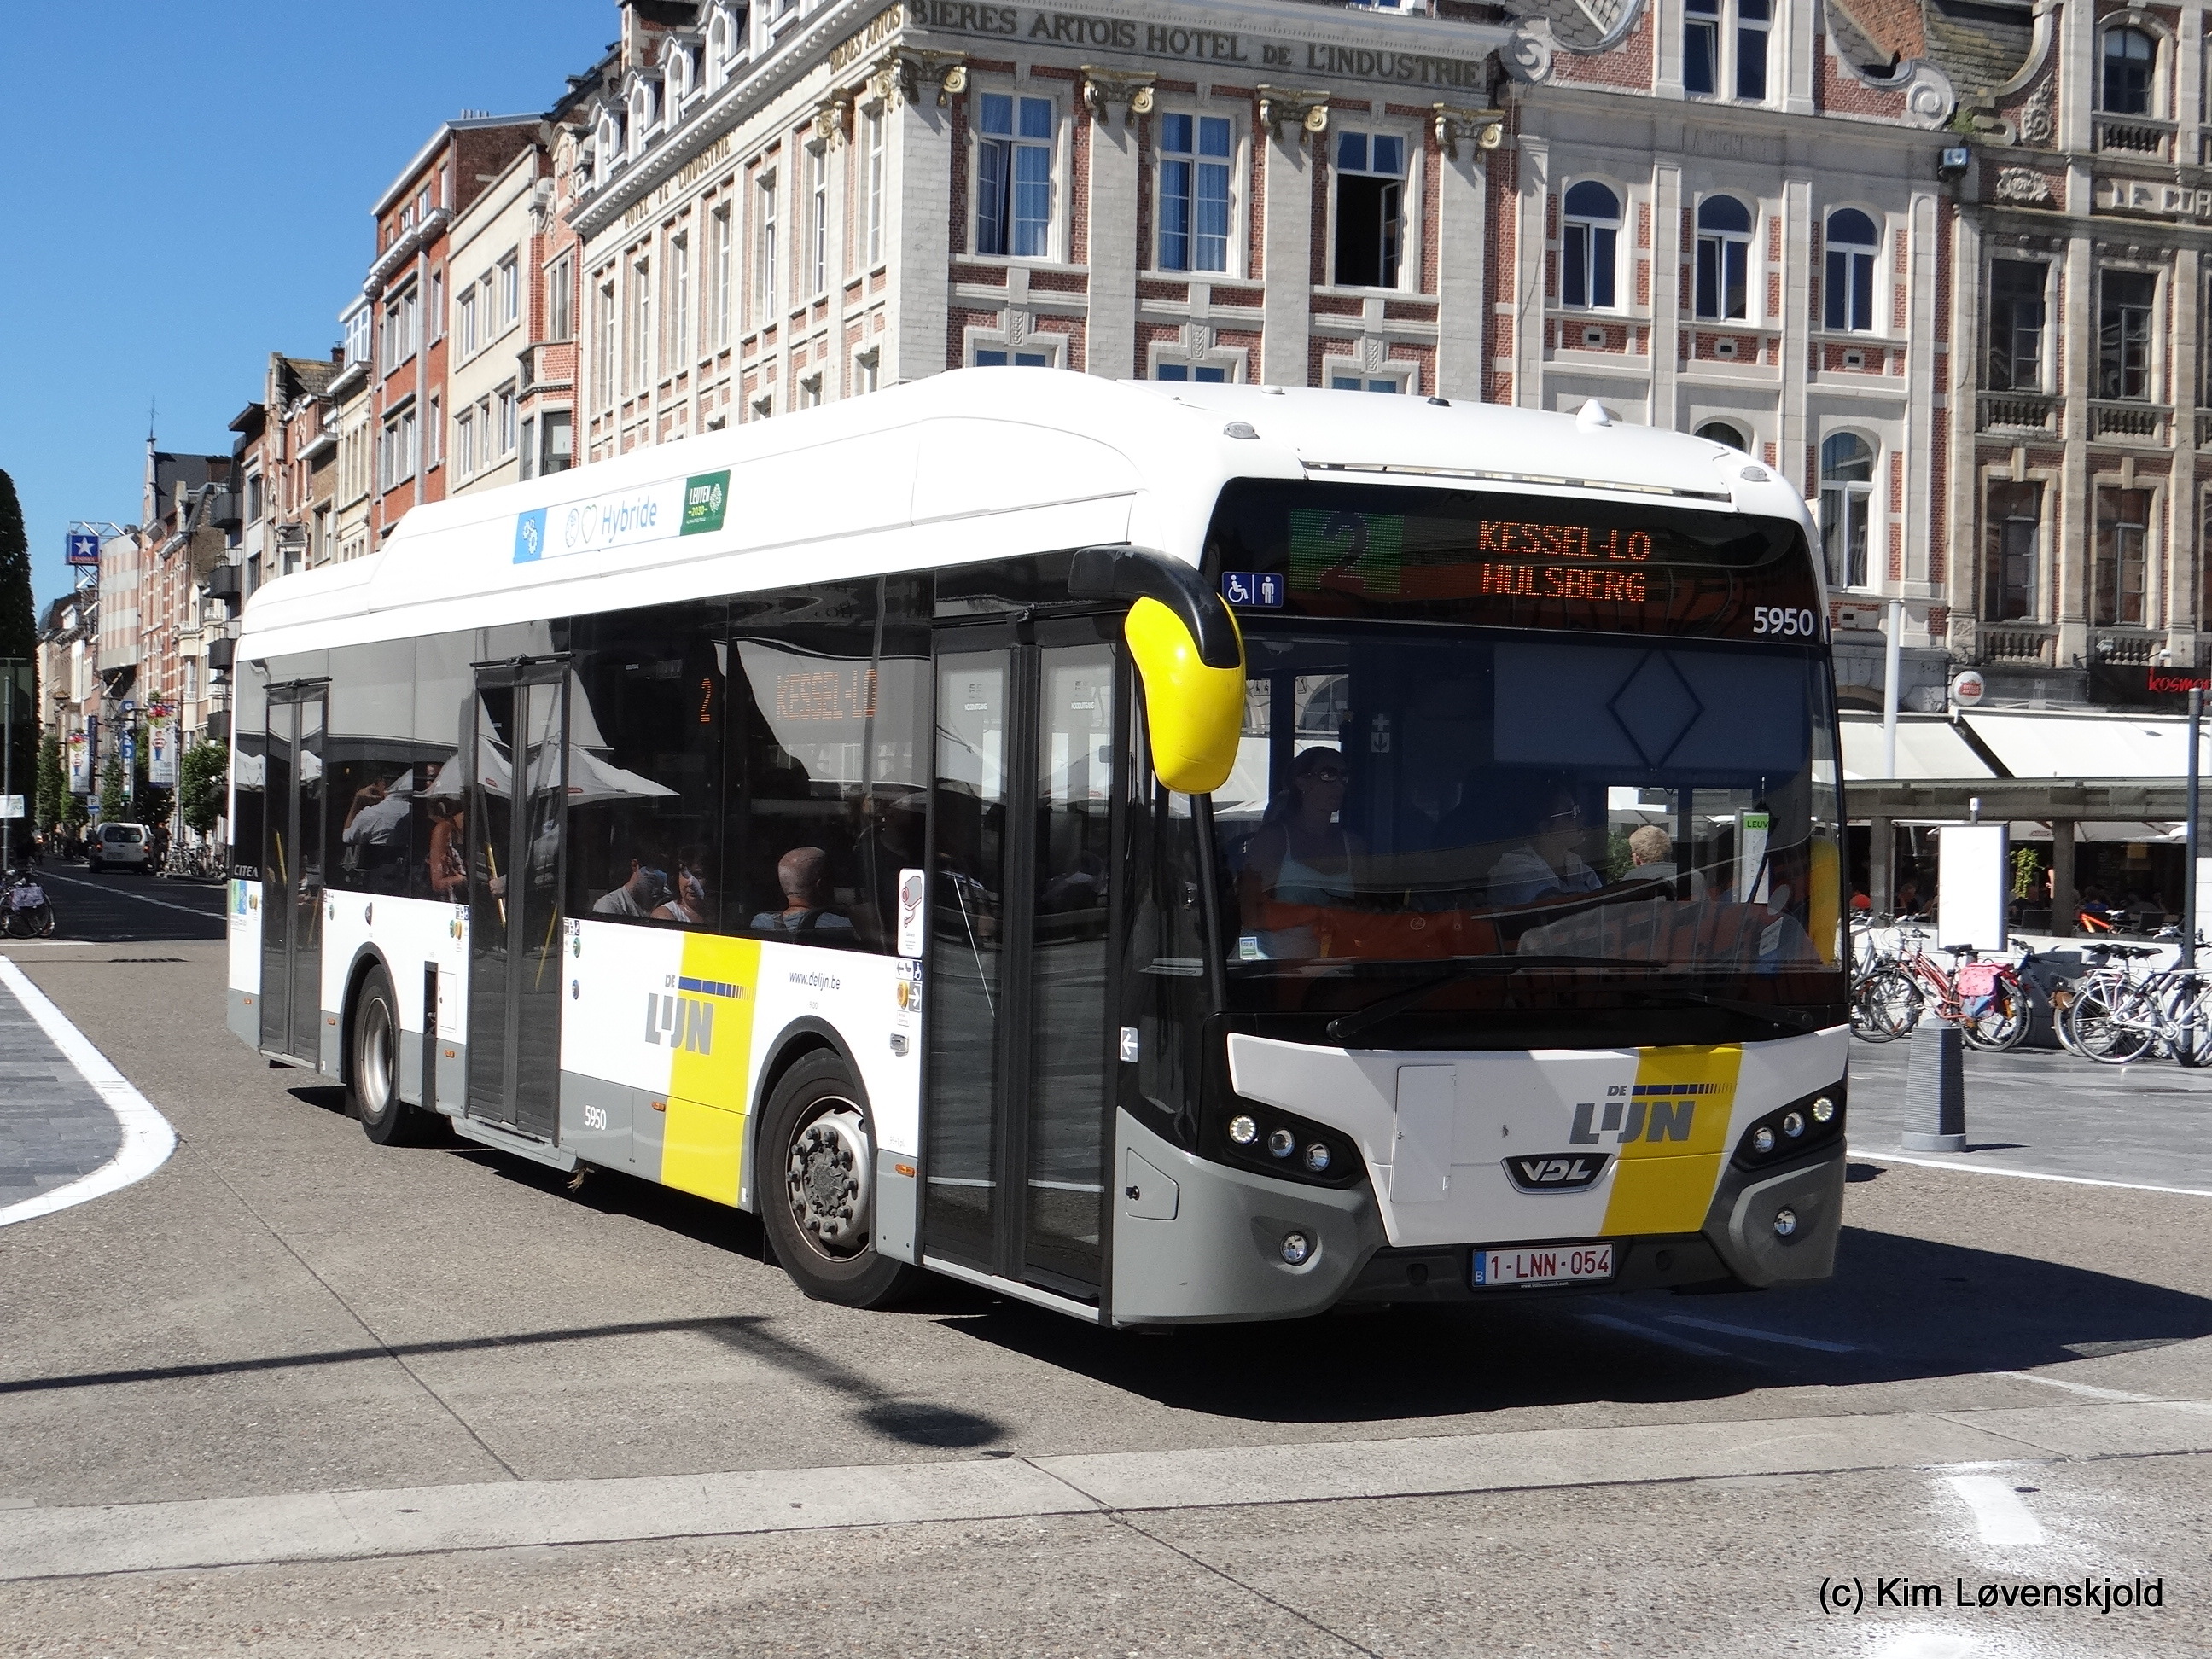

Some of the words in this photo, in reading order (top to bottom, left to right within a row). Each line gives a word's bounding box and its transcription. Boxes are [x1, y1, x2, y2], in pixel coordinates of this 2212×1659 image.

[1029, 13, 1136, 49] ARTOIS
[1148, 26, 1247, 61] HOTEL
[1262, 44, 1291, 67] DE
[1307, 45, 1481, 87] L'INDUSTRIE
[2111, 182, 2147, 209] LE
[689, 485, 711, 505] LEUVEN
[601, 495, 657, 544] Hybride
[1318, 510, 1370, 591] 2
[1479, 520, 1651, 561] KESSEL-LO
[1481, 563, 1646, 602] HULSBERG
[1752, 606, 1813, 637] 5950
[700, 678, 712, 722] 2
[776, 668, 877, 721] KESSEL-LO
[234, 864, 259, 877] CITEA
[665, 975, 676, 988] DE
[789, 971, 841, 991] www.delijn.be
[645, 992, 713, 1055] LIJN
[1607, 1085, 1627, 1097] DE
[585, 1104, 607, 1131] 5950
[1569, 1100, 1696, 1145] LIJN
[1521, 1159, 1592, 1182] VDL
[1475, 1271, 1484, 1282] B
[1491, 1249, 1609, 1279] 1-LNN-054
